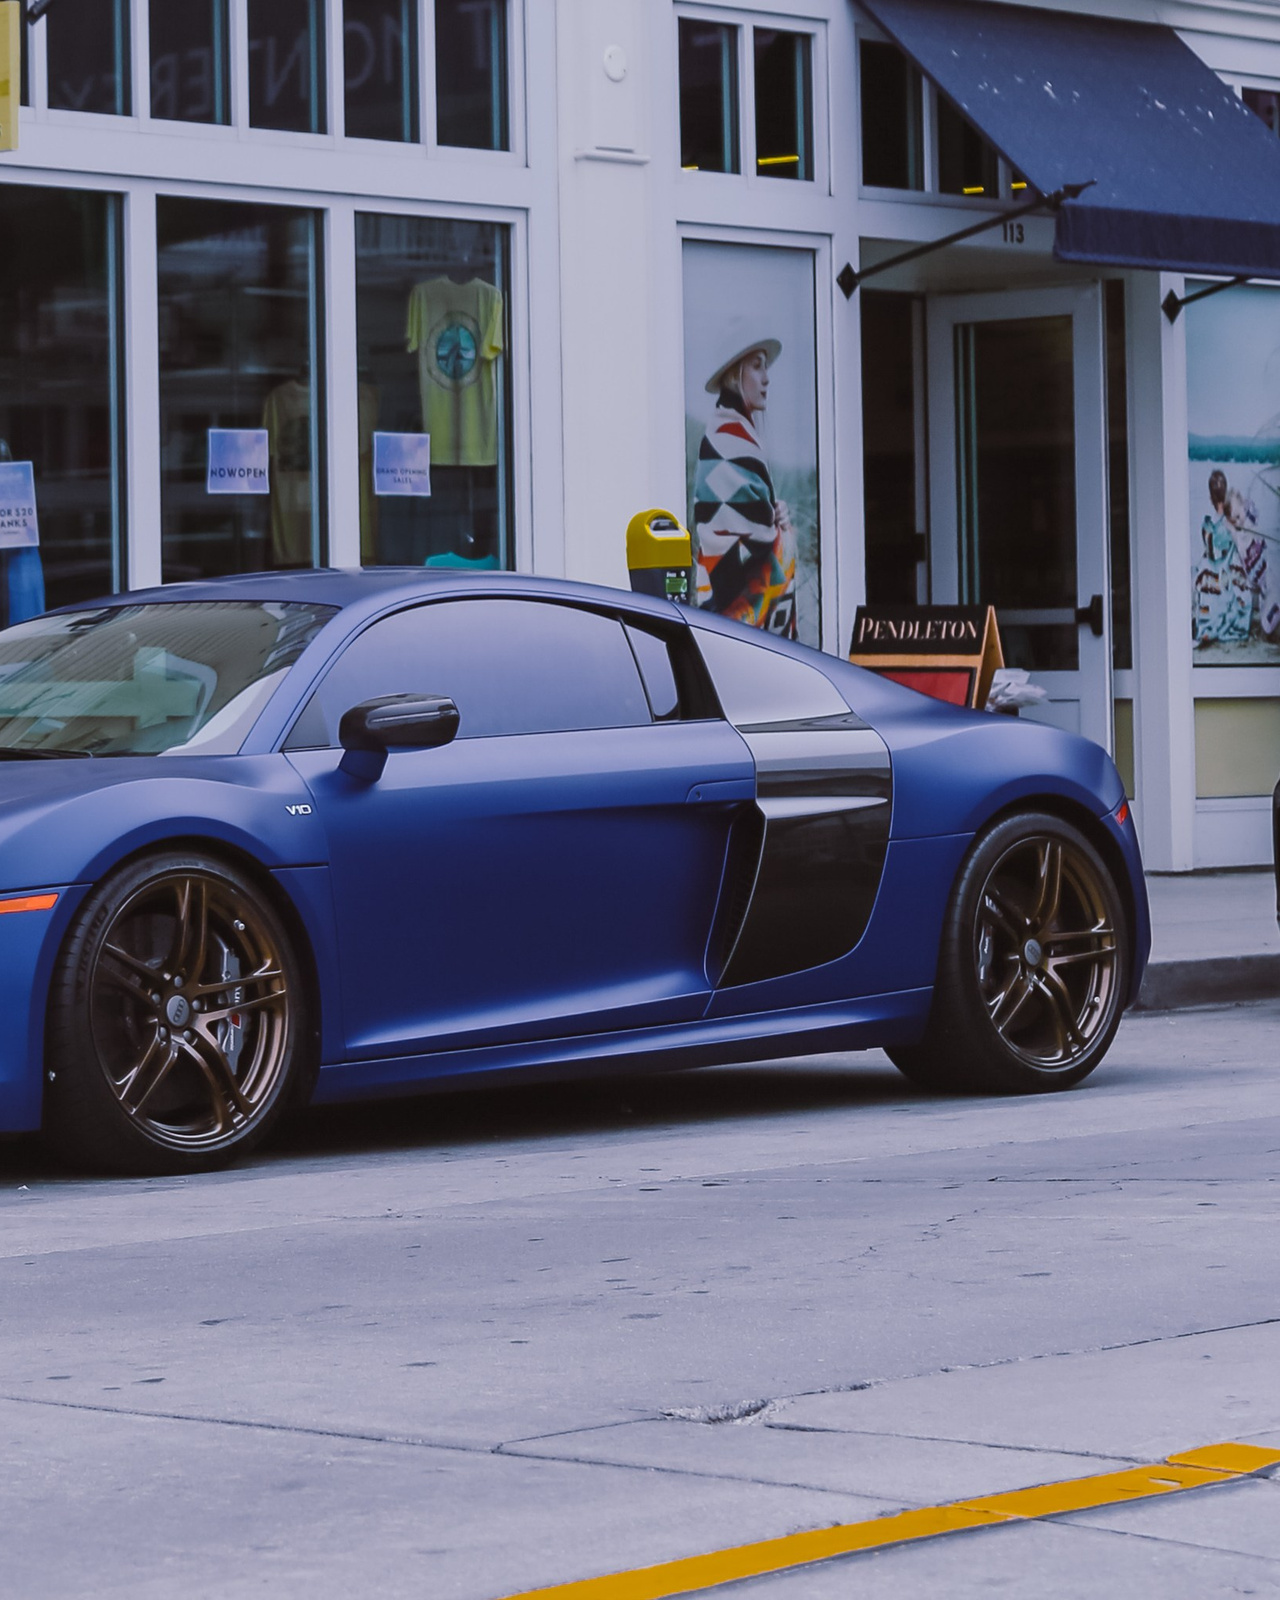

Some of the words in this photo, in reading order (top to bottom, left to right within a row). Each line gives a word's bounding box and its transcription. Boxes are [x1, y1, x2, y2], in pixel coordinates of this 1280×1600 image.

[1002, 221, 1025, 245] 113
[376, 467, 398, 475] GRAND
[400, 468, 427, 476] OPENING
[858, 617, 978, 644] PENDLETON
[284, 804, 312, 816] V10
